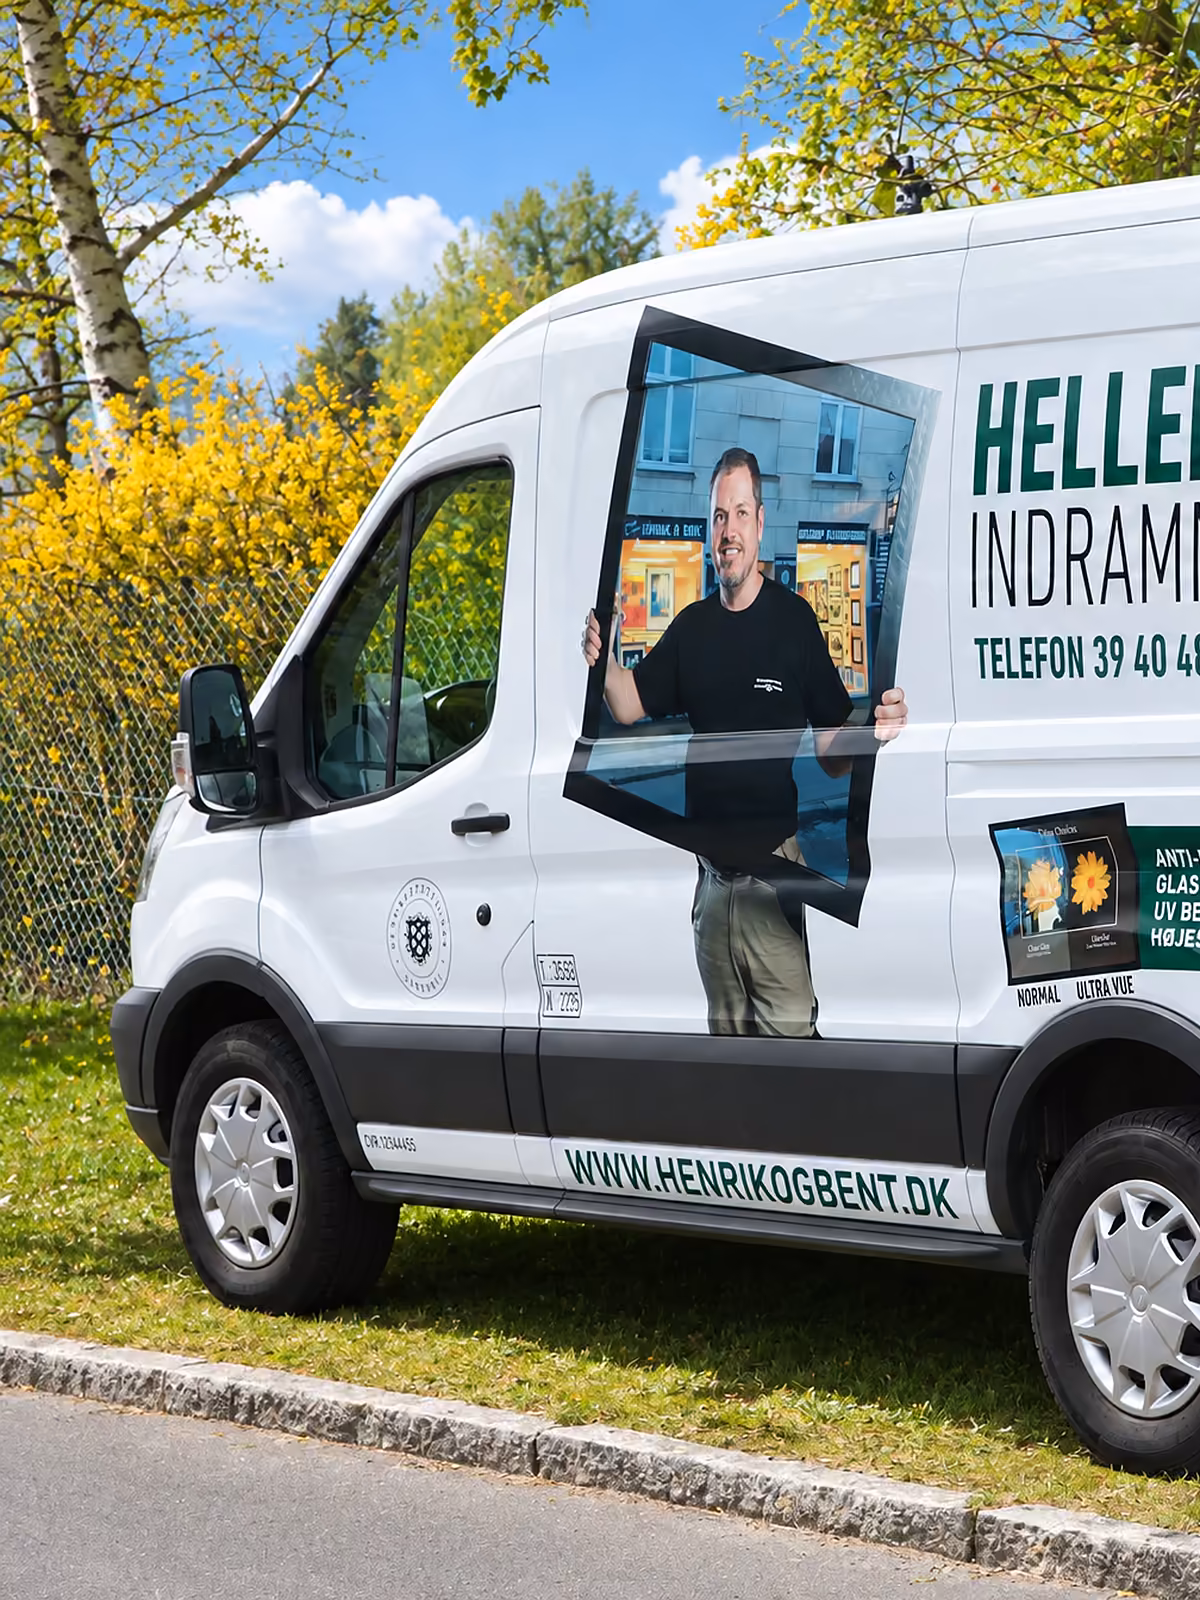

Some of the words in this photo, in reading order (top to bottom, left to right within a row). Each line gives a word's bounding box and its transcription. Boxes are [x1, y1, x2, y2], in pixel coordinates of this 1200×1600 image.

[974, 635, 1084, 679] TELEFON
[1093, 634, 1125, 678] 39
[1134, 633, 1167, 677] 40
[1156, 874, 1200, 895] GLAS
[1154, 901, 1176, 921] UV
[1017, 984, 1062, 1008] NORMAL
[1076, 977, 1111, 1001] ULTRA
[1111, 975, 1135, 997] VUE
[564, 1149, 959, 1220] WWW.HENRIKOGBENT.DK
